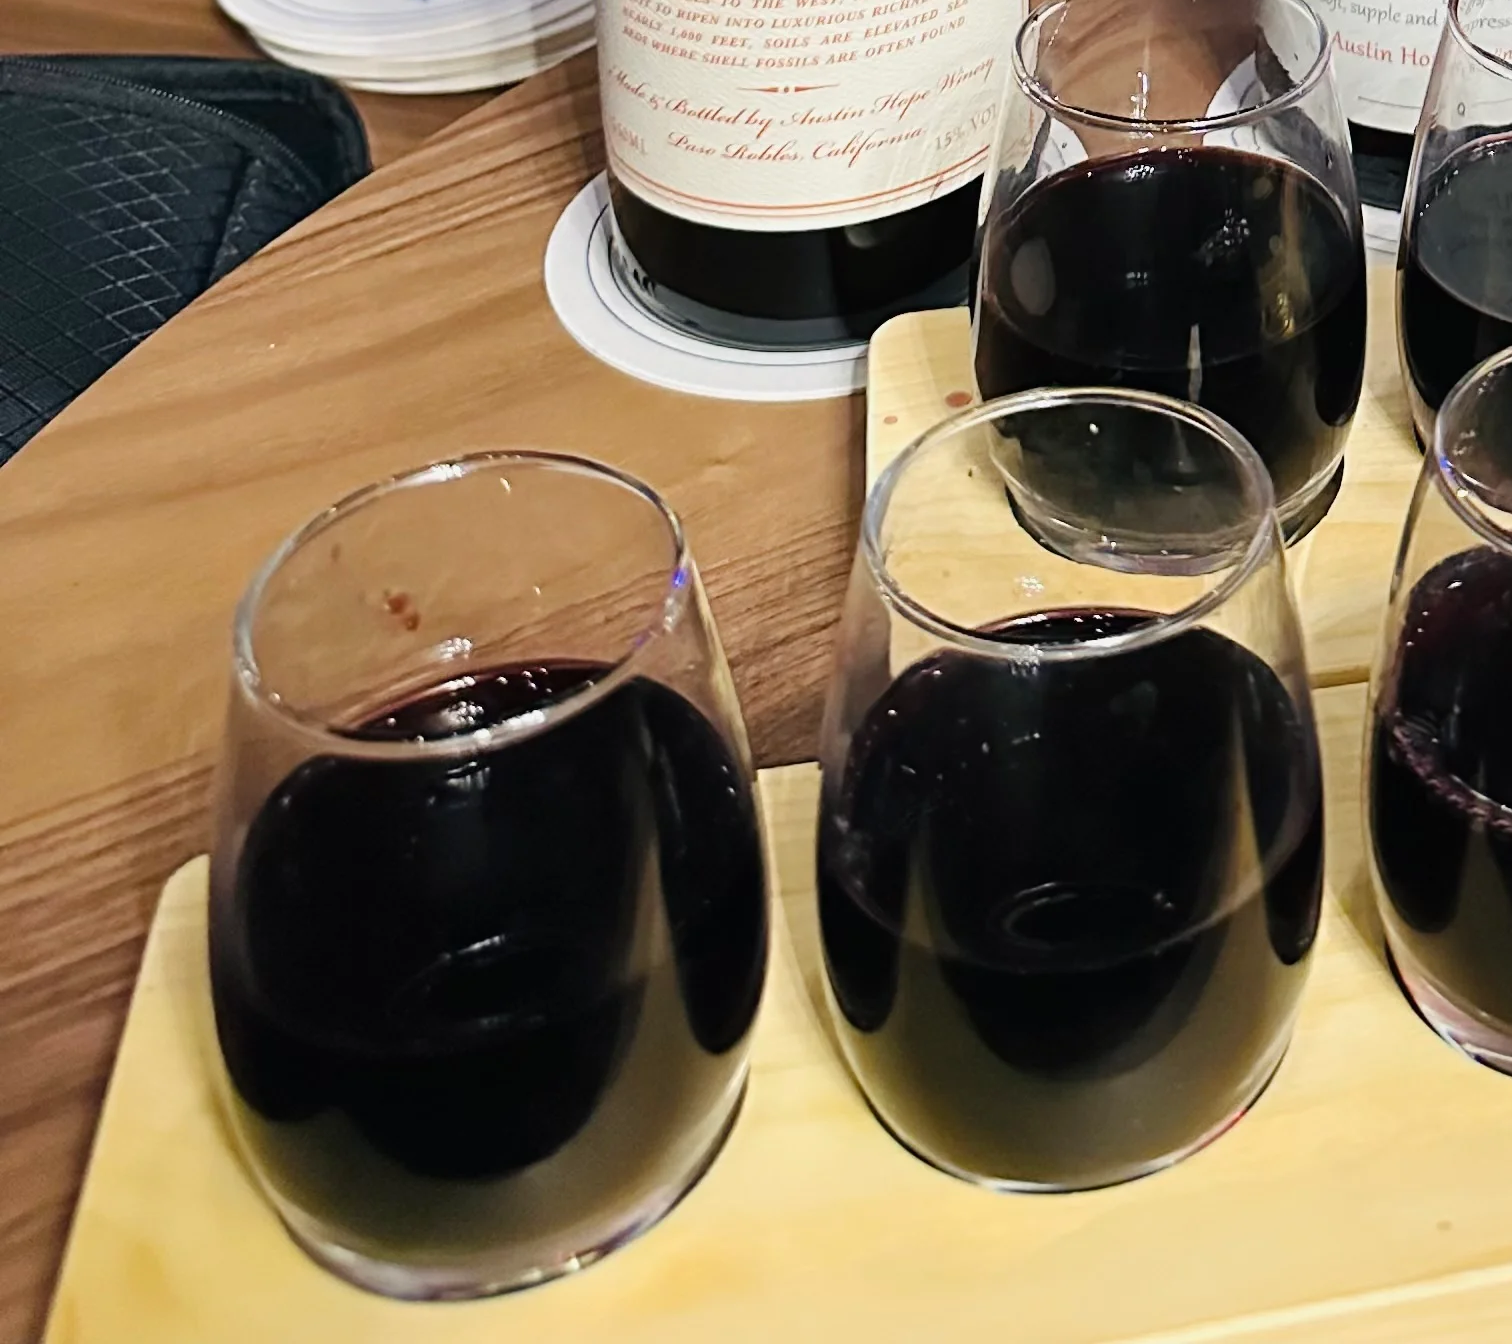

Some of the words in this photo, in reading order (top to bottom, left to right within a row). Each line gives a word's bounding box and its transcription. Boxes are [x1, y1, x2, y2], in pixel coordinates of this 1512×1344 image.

[676, 9, 720, 25] RIPEN
[725, 16, 765, 28] INTO
[771, 10, 866, 29] LUXURIOUS
[763, 36, 811, 49] SOILS
[820, 31, 853, 46] ARE
[864, 9, 938, 39] ELEVATED
[1350, 2, 1402, 25] supple
[1405, 8, 1438, 26] and
[651, 39, 697, 61] WHERE
[701, 53, 749, 67] SHELL
[755, 56, 820, 68] FOSSILS
[825, 50, 858, 65] ARE
[865, 35, 915, 59] OFTEN
[920, 15, 966, 44] FOUND
[1331, 30, 1393, 63] Austin
[665, 98, 747, 125] Bottled
[745, 108, 772, 139] by
[779, 106, 864, 127] Austin
[870, 89, 931, 123] Hope
[936, 57, 995, 93] Winery
[667, 131, 717, 156] Paso
